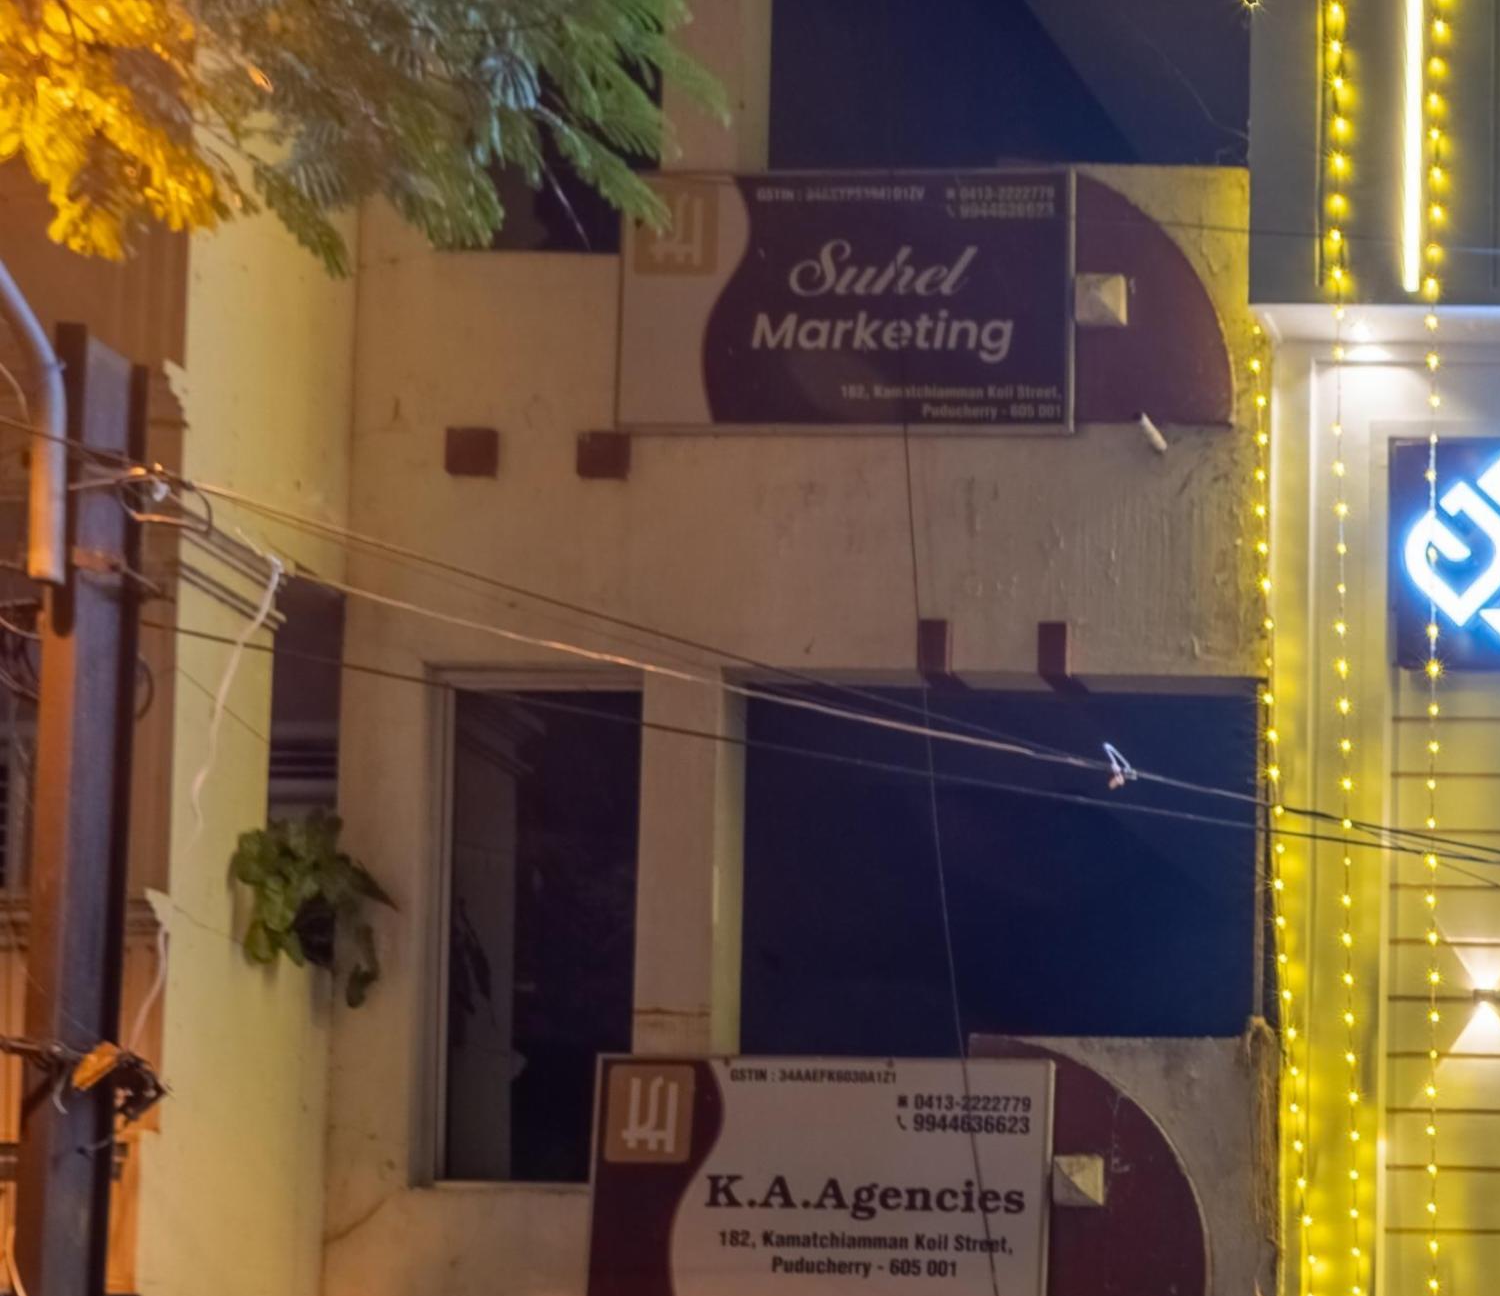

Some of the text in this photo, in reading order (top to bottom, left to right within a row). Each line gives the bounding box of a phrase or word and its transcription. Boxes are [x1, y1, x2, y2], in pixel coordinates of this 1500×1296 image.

[788, 237, 979, 297] Suhel
[751, 308, 1015, 364] Marketing
[1017, 384, 1063, 401] Street,
[730, 1067, 768, 1083] GSTIN
[913, 1093, 1032, 1113] 0413-2222779
[912, 1112, 1031, 1135] 9944636623
[704, 1173, 1026, 1221] K.A.Agencies
[718, 1230, 1013, 1255] 182, Kamatchiamman Koil Street,
[771, 1256, 872, 1278] Puducherry
[888, 1258, 921, 1276] 605
[927, 1259, 958, 1277] 001
